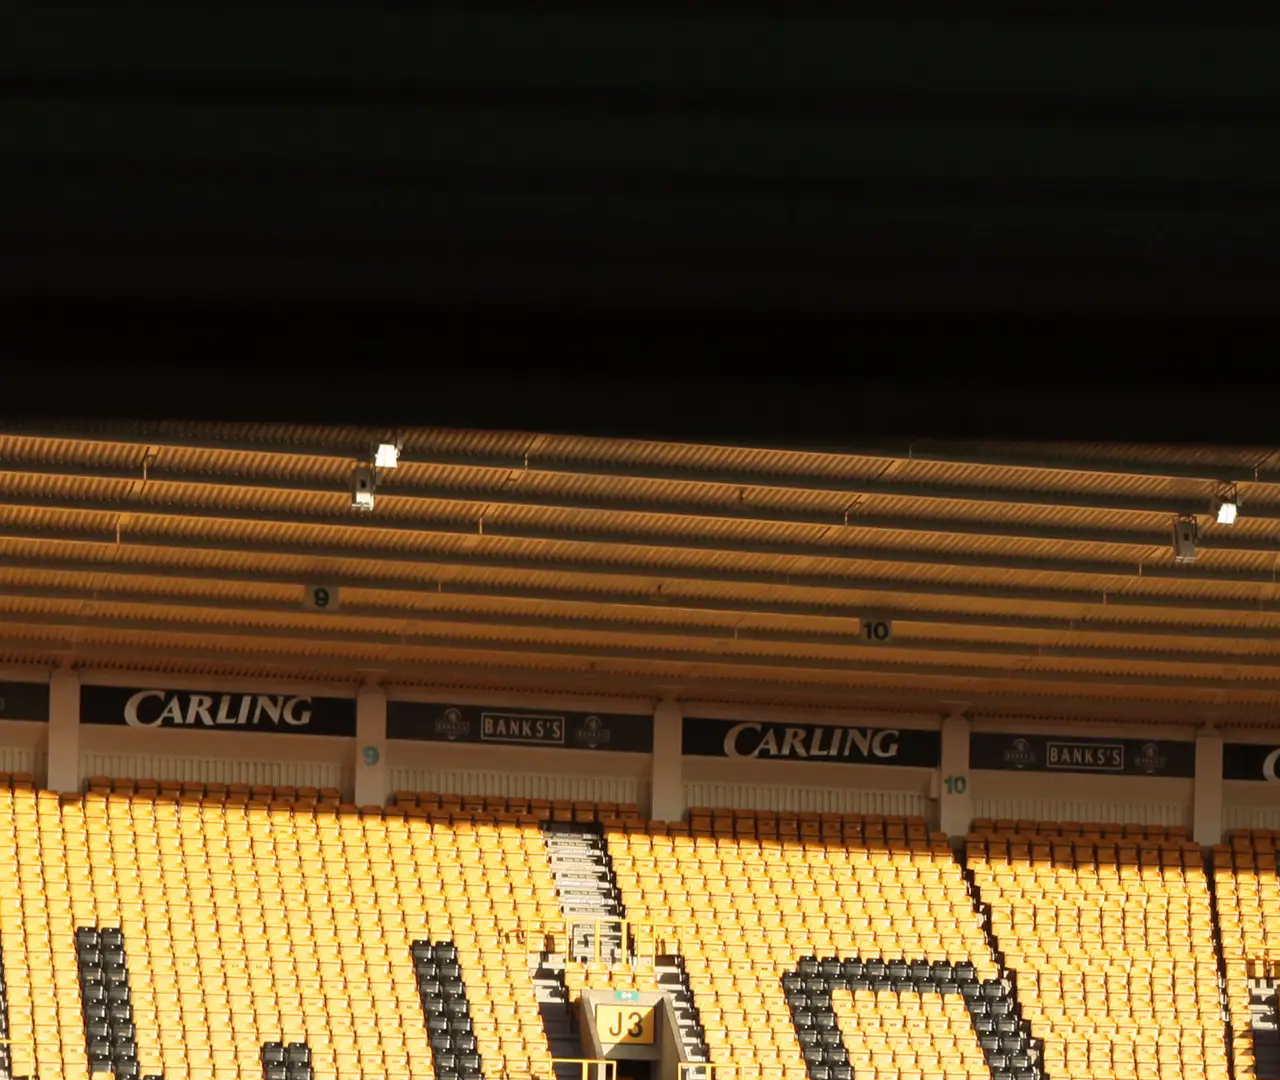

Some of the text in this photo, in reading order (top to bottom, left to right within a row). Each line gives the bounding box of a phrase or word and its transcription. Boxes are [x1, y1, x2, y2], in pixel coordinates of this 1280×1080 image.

[313, 588, 330, 606] 9
[862, 622, 889, 640] 10
[124, 690, 312, 728] CARLING
[483, 717, 561, 739] BANKS'S
[723, 723, 899, 759] CARLING
[362, 746, 380, 766] 9
[1050, 746, 1120, 766] BANKS'S
[944, 776, 967, 794] 10
[609, 1012, 642, 1037] J3
